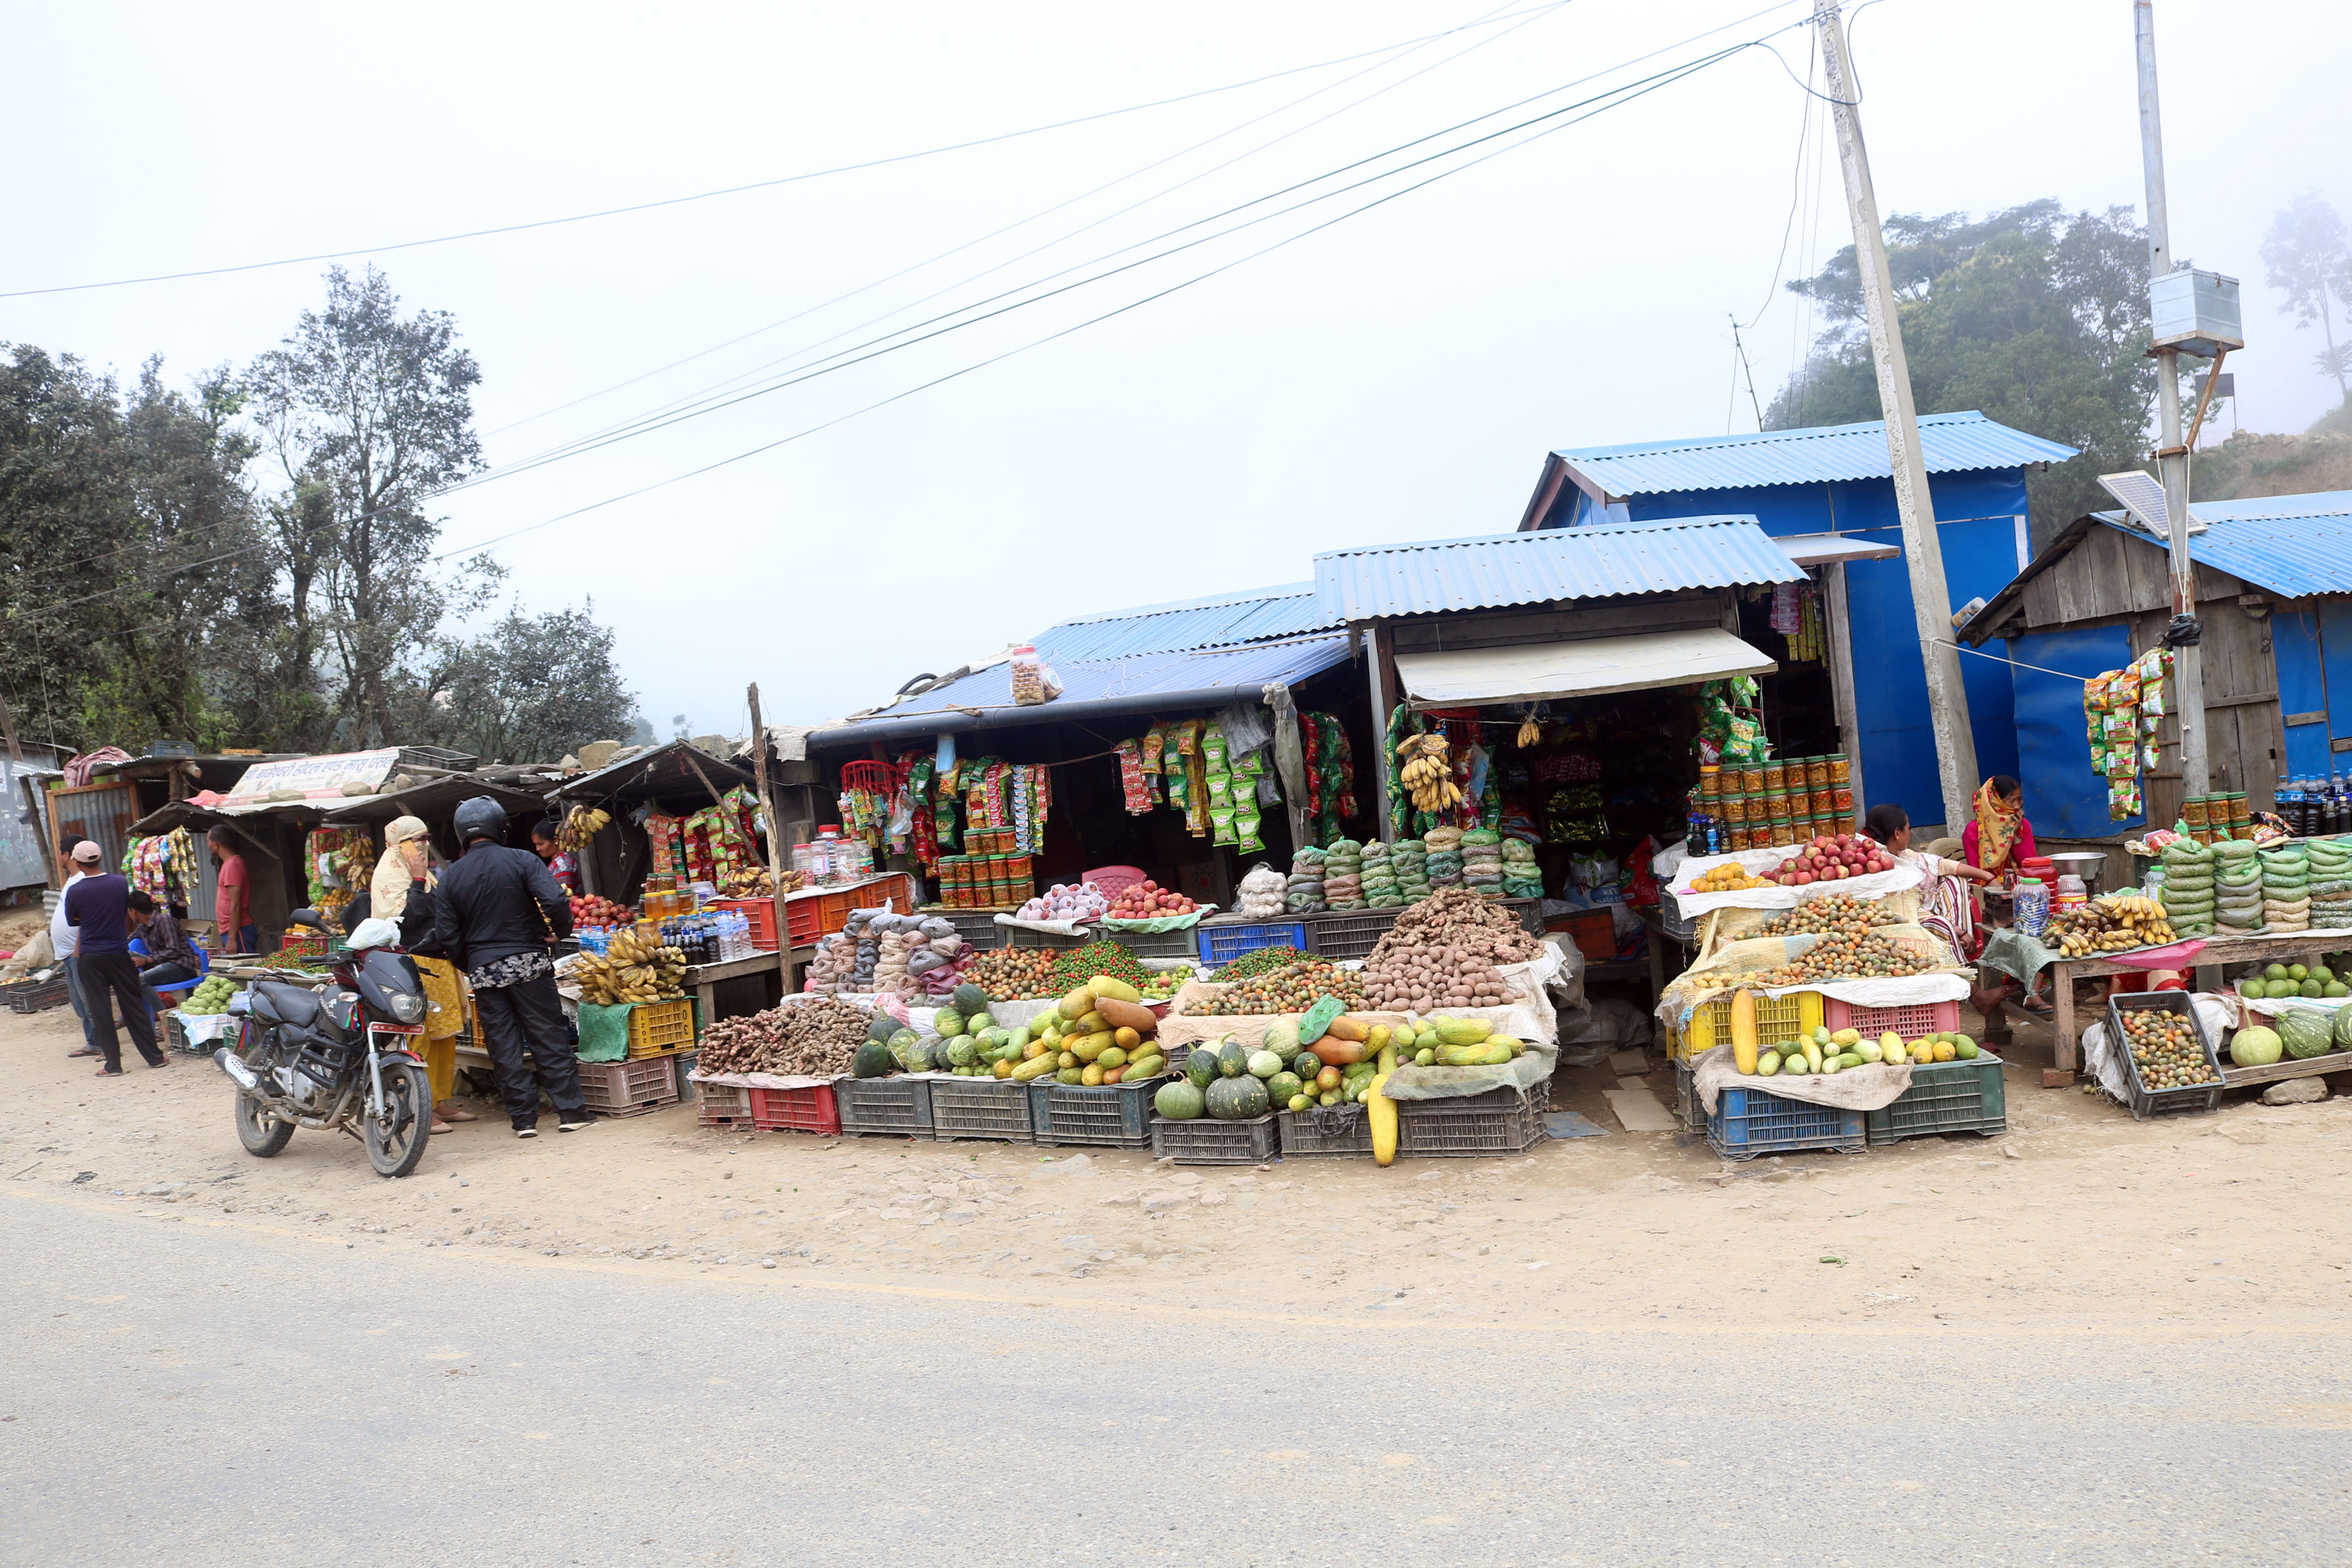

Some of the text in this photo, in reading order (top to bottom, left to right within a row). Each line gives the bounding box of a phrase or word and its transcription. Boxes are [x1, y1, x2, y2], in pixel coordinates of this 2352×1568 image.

[244, 766, 259, 781] श्री
[292, 760, 323, 776] होटल
[321, 759, 346, 773] एण्ड
[344, 758, 370, 773] मासु
